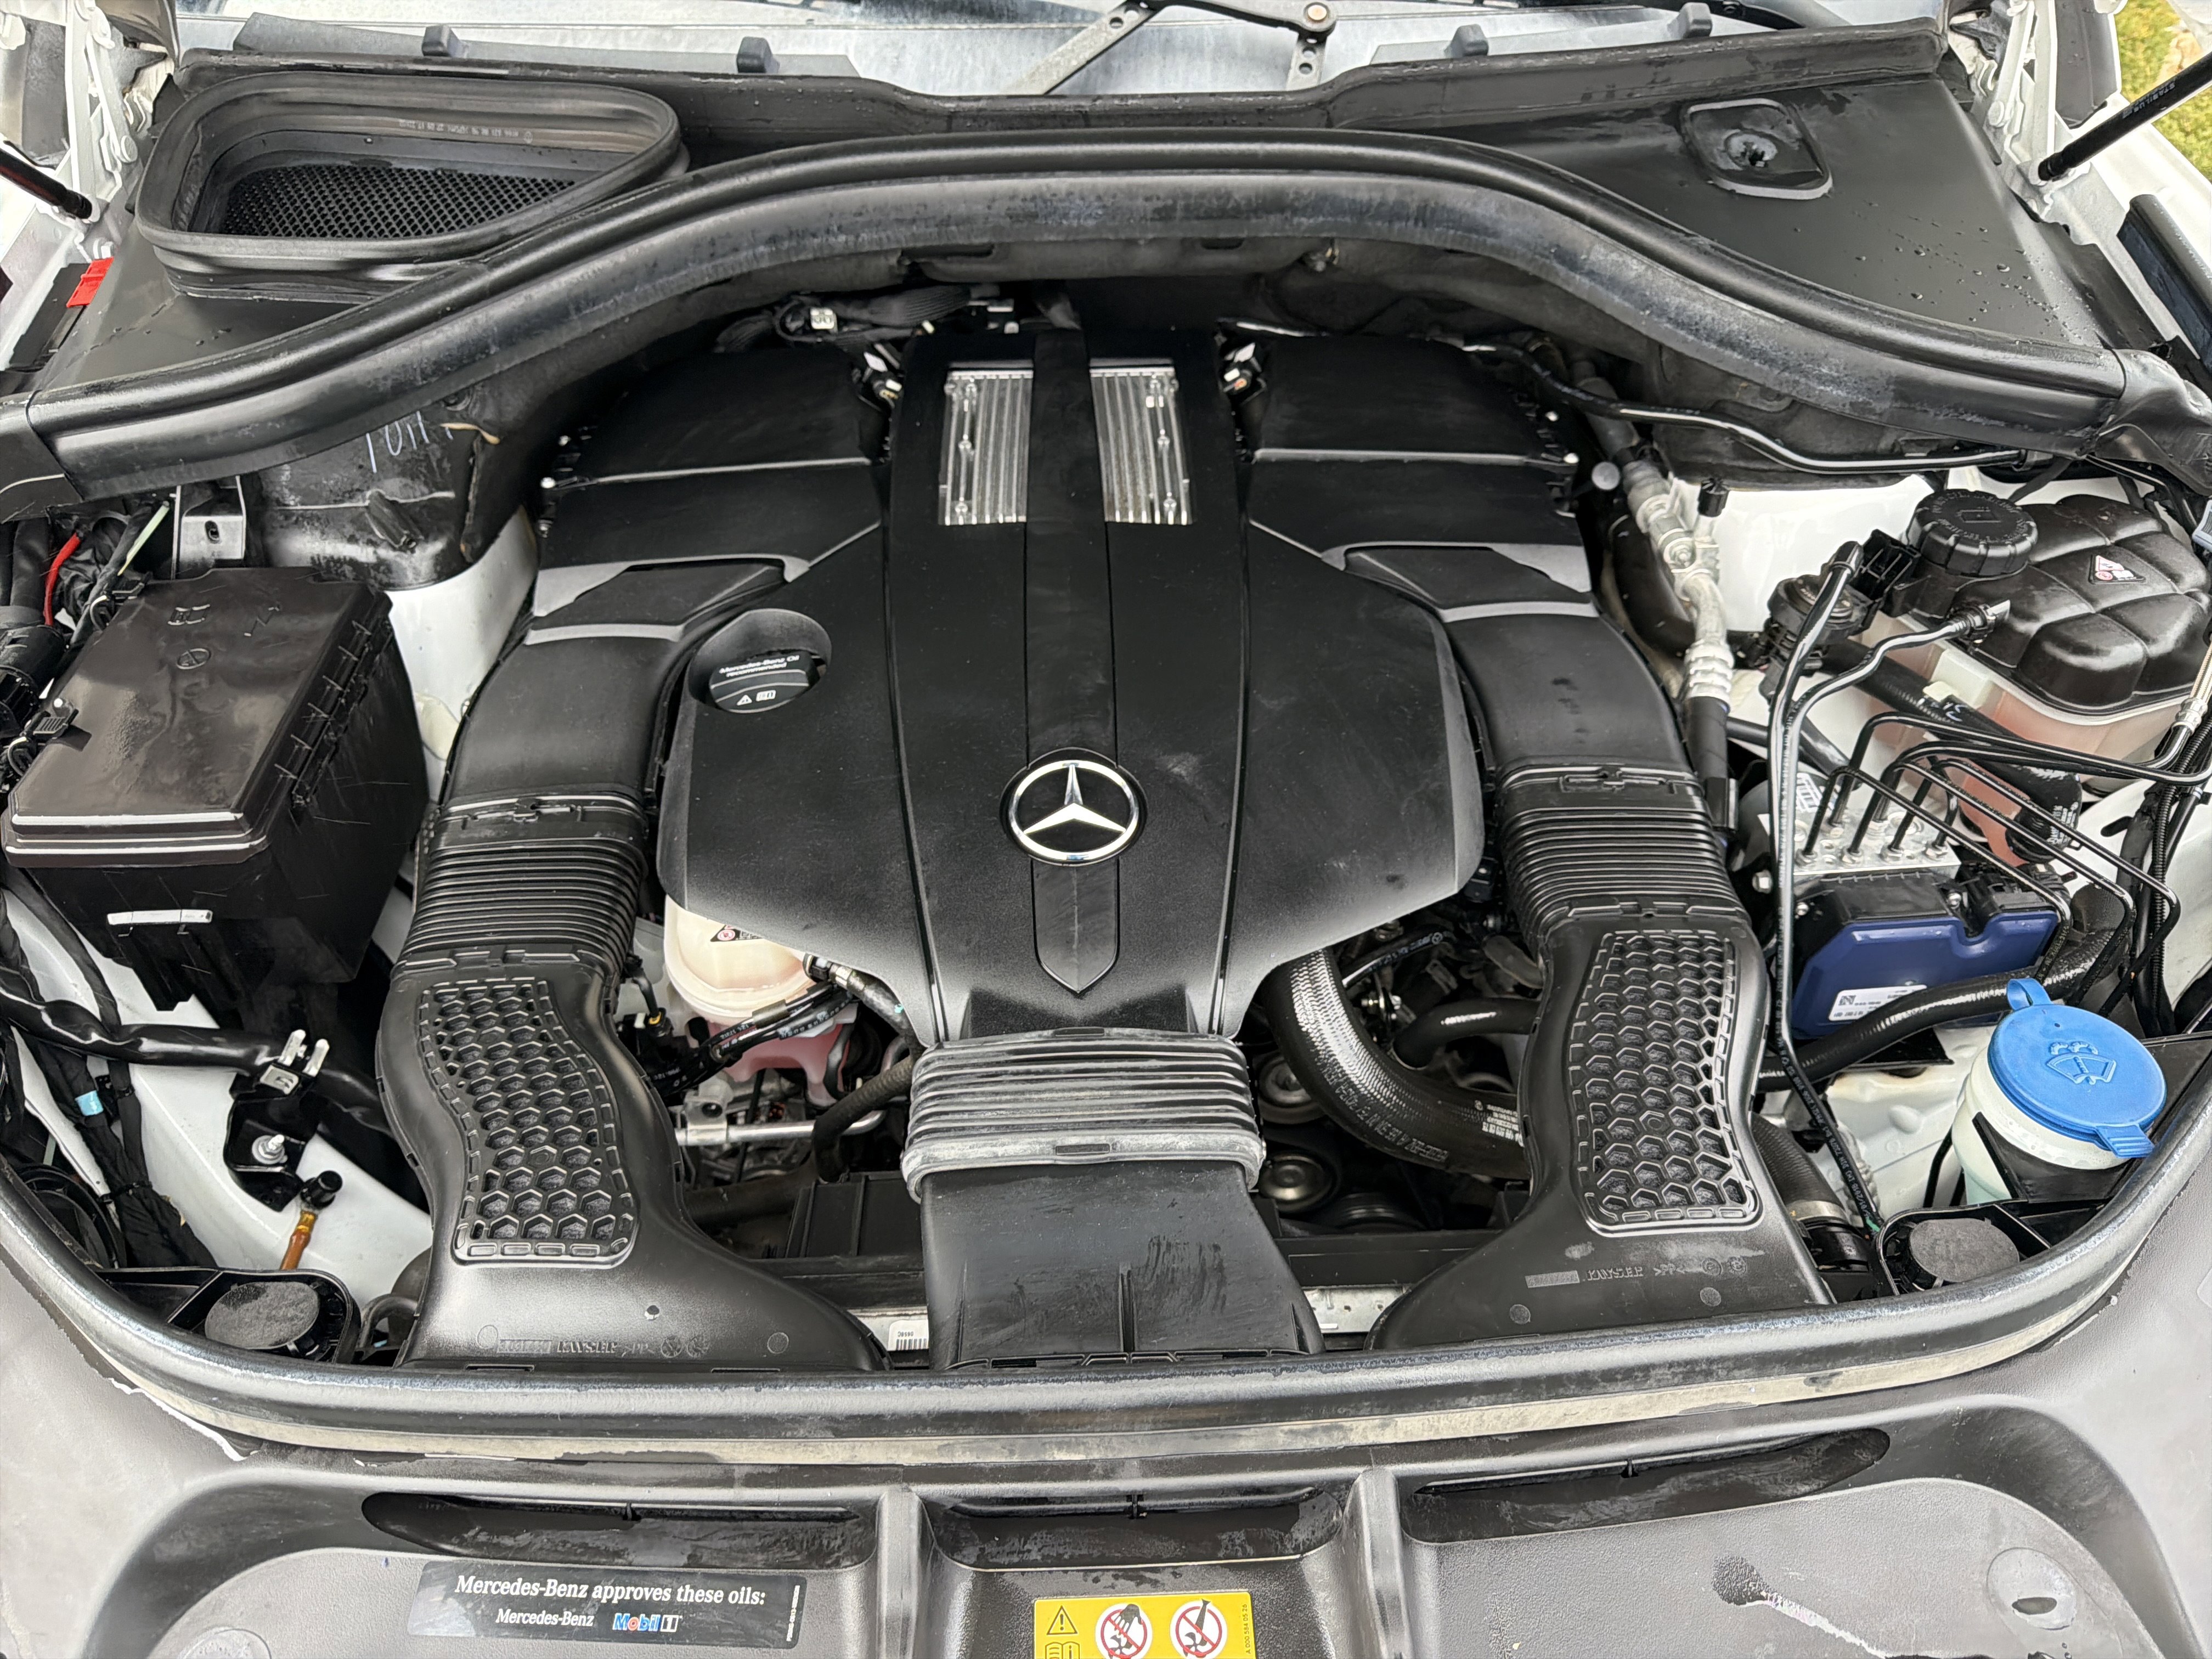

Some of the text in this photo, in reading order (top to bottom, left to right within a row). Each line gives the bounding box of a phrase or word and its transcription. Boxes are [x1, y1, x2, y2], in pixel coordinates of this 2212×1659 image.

[454, 1575, 766, 1605] Mercedes-Benz approves these oils:
[495, 1609, 594, 1627] Mercedes-Benz
[613, 1613, 661, 1632] Mobil
